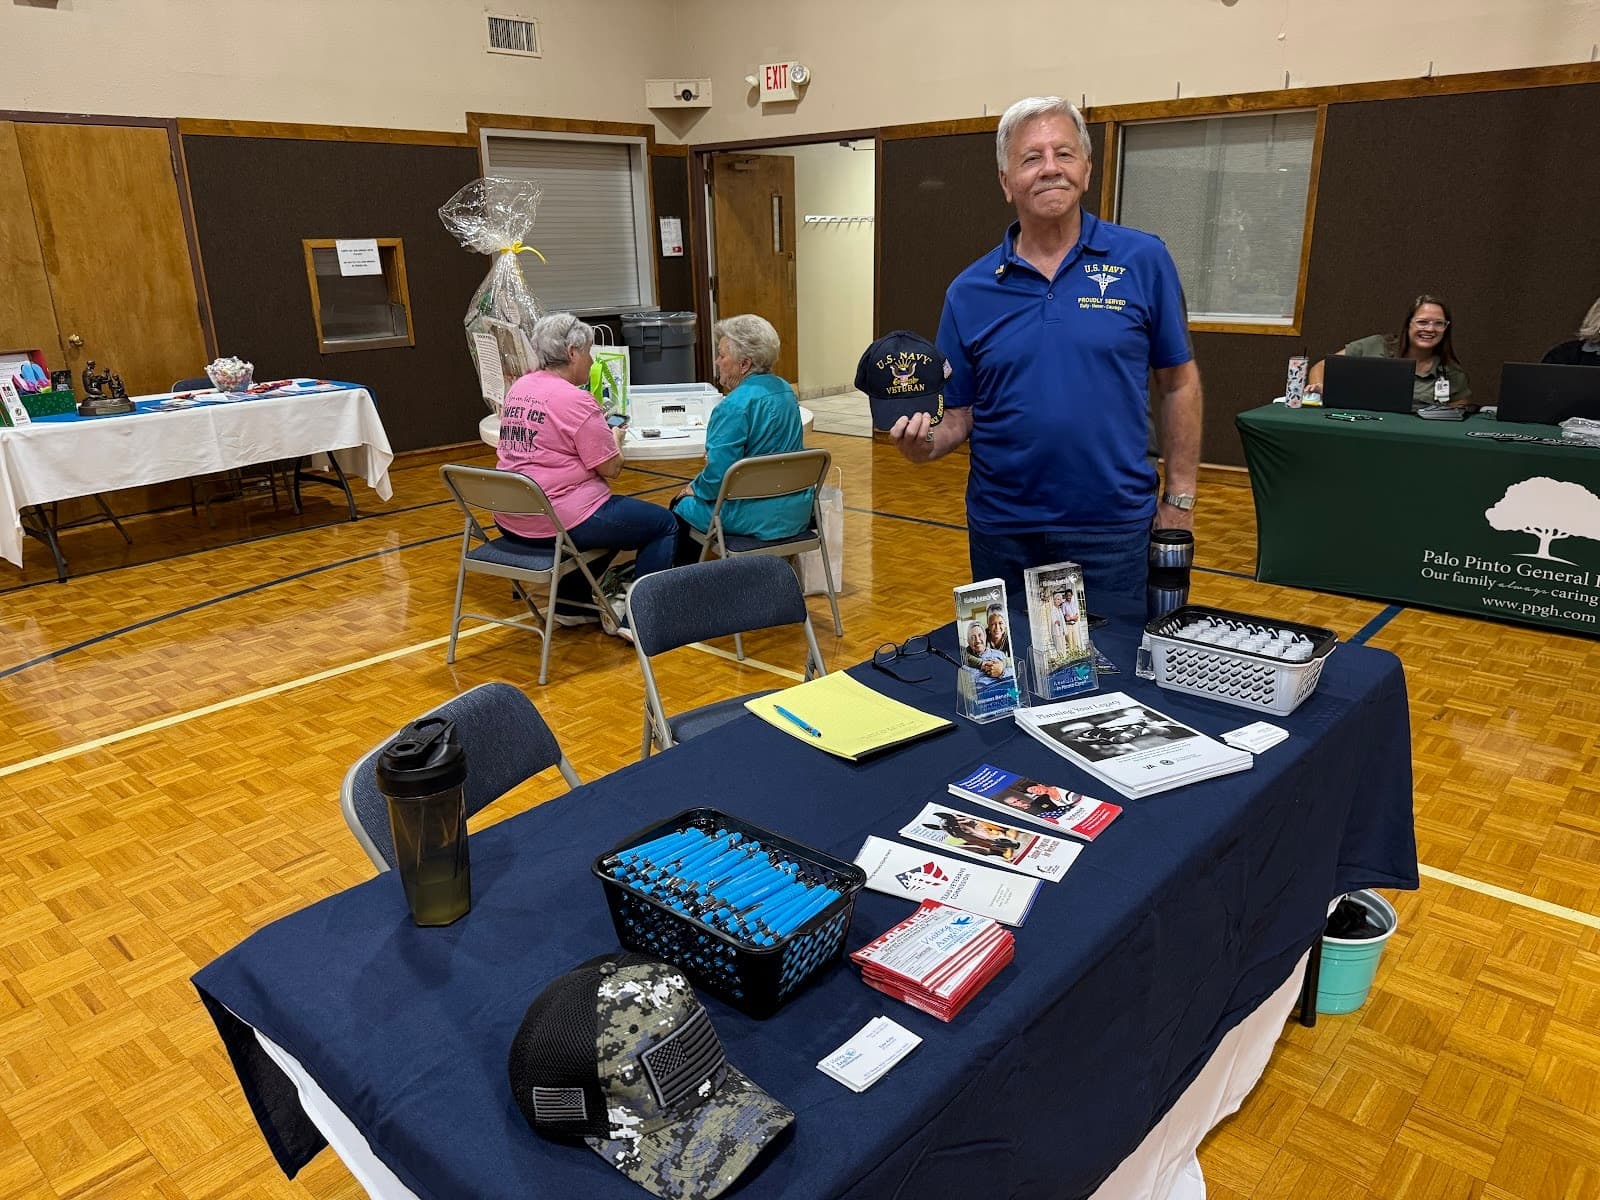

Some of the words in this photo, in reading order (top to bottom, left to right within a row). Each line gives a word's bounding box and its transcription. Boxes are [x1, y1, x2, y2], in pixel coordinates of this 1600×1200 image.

[766, 64, 788, 90] EXIT
[1084, 264, 1100, 273] U.S.
[1102, 264, 1126, 275] NAVY
[1104, 298, 1126, 306] SERVED
[876, 354, 897, 370] U.S.
[899, 351, 931, 365] NAVY
[886, 383, 925, 395] VETERAN
[503, 406, 526, 419] WEET
[526, 408, 546, 425] ICE
[1423, 549, 1460, 568] Palo
[1464, 555, 1512, 575] Pinto
[1516, 563, 1590, 587] General
[1421, 567, 1450, 582] Our
[1452, 571, 1497, 591] family
[1497, 580, 1550, 597] always
[1550, 589, 1600, 607] caring
[1481, 596, 1596, 623] www.ppgh.com
[1035, 707, 1075, 720] Planning
[1073, 703, 1094, 716] Your
[1094, 699, 1121, 712] Legacy
[1143, 763, 1157, 771] VA
[950, 867, 967, 892] VETERANS
[950, 873, 972, 900] COMMISSION
[905, 906, 933, 930] LIFE
[920, 924, 951, 946] Visiting
[935, 924, 970, 949] Angels
